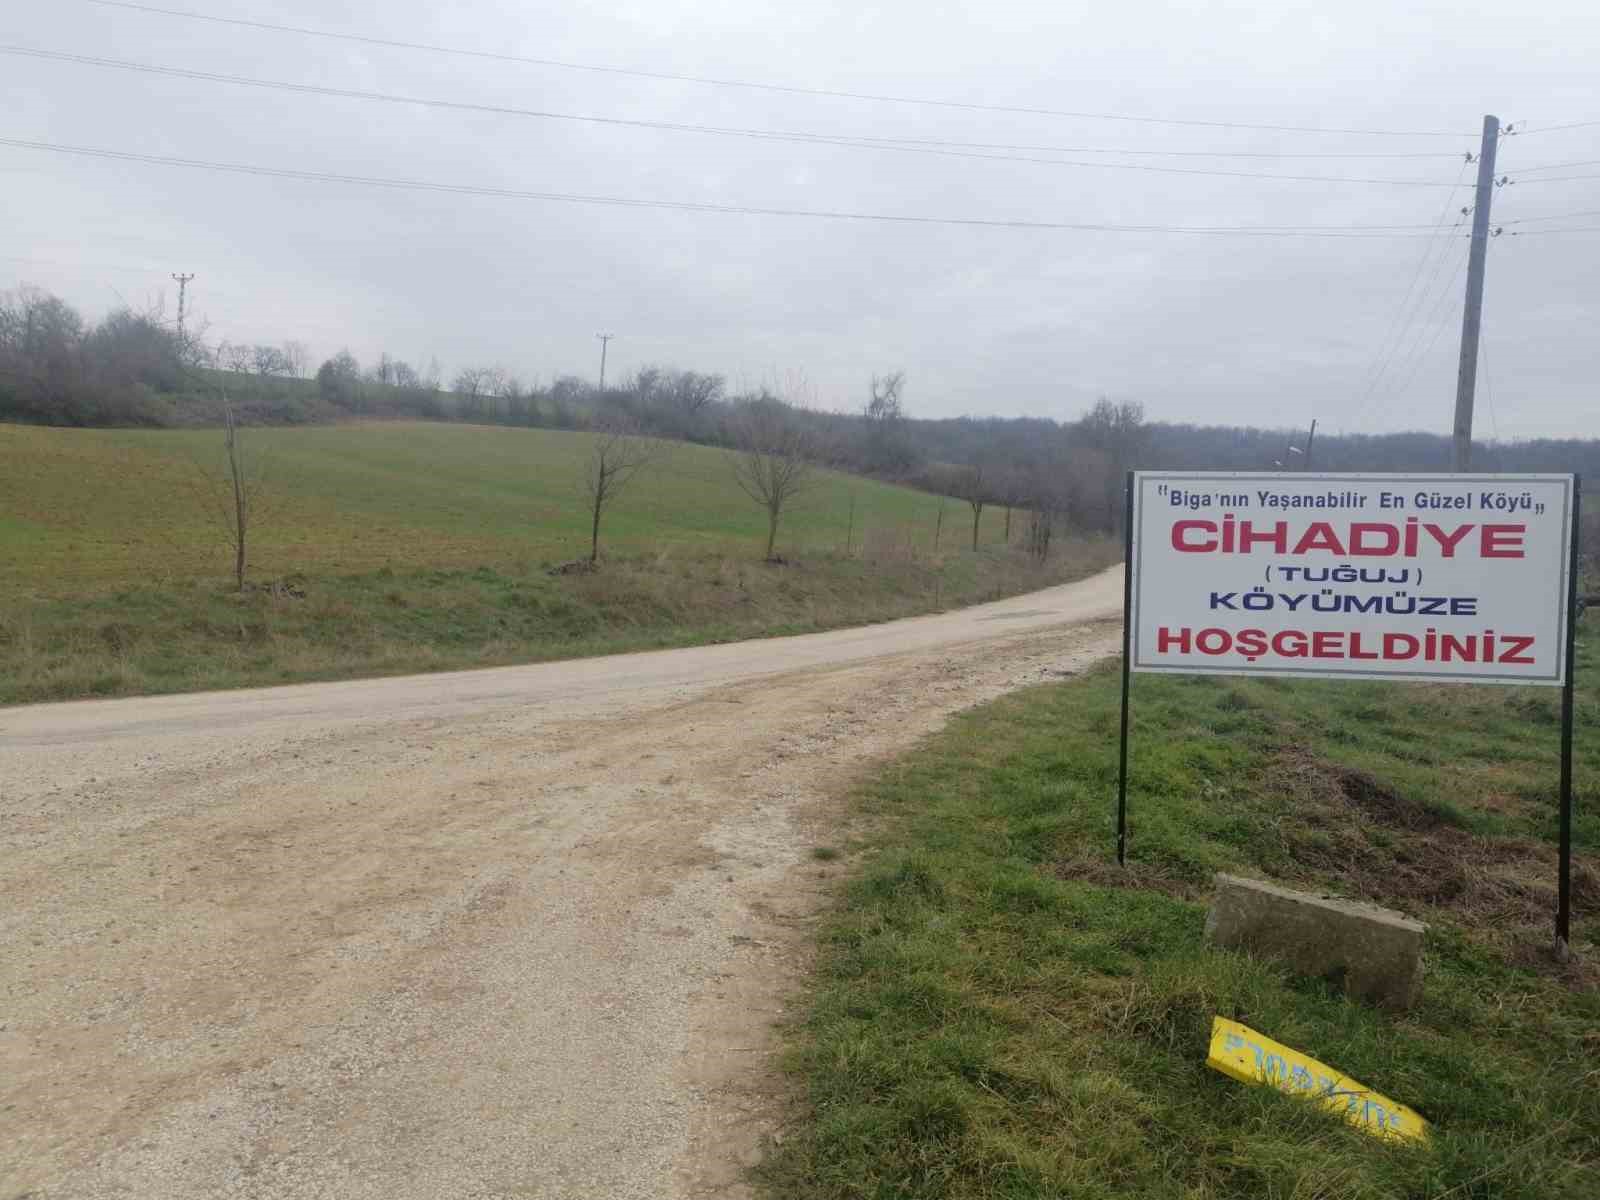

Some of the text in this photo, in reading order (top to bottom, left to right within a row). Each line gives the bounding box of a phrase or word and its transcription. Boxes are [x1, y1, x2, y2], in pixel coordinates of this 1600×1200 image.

[1258, 491, 1367, 511] Yaşanabilir
[1380, 492, 1404, 508] En
[1415, 492, 1472, 509] Güzel
[1172, 512, 1526, 558] CİHADİYE
[1210, 586, 1478, 615] KÖYÜMÜZE
[1157, 628, 1535, 664] HOŞGELDİNİZ
